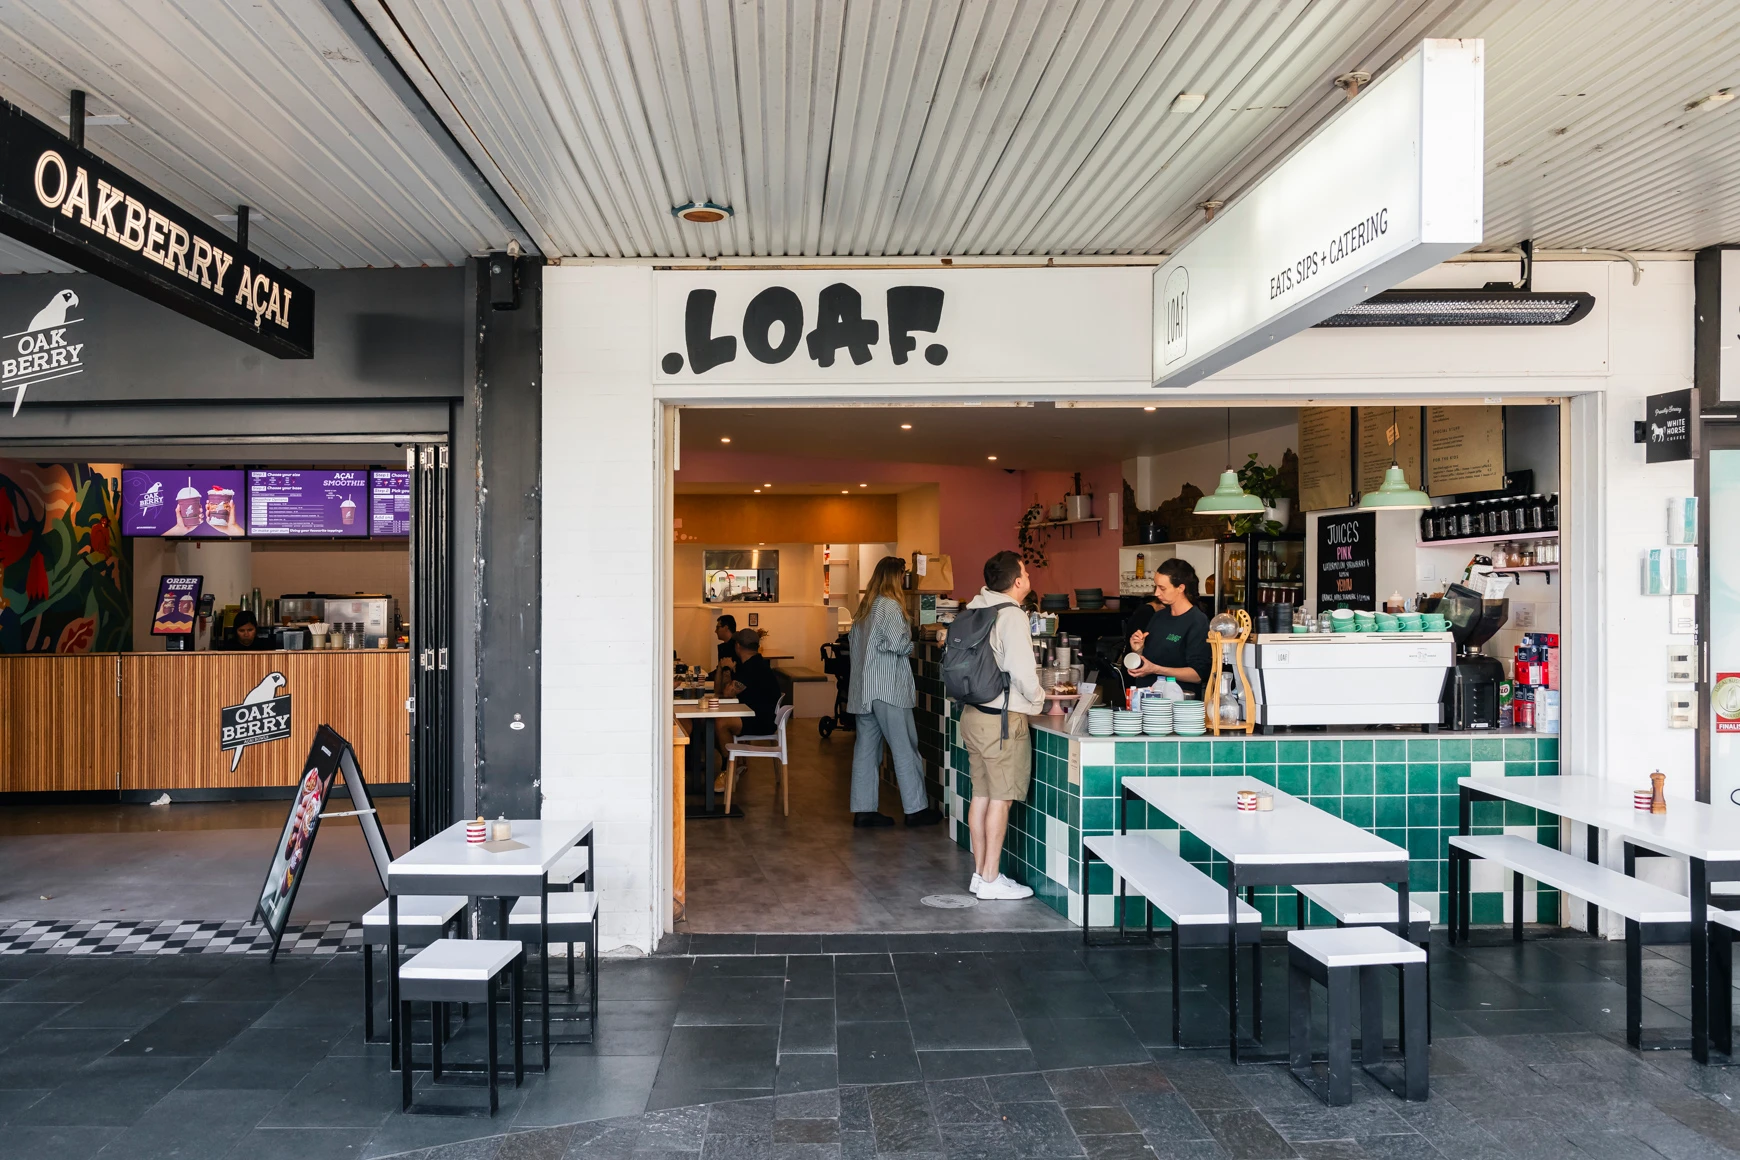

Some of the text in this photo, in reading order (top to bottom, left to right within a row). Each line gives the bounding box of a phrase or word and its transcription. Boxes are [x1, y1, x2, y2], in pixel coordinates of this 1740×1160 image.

[34, 149, 293, 329] OAKBERRY AÇAI
[1270, 207, 1389, 300] EATS, SIPS + CATERING
[1167, 291, 1186, 346] LOAF
[17, 327, 68, 355] OAK
[2, 343, 84, 379] BERRY
[1666, 418, 1686, 428] WHITE
[1666, 426, 1686, 435] HORSE
[139, 496, 164, 505] BERRY
[1327, 520, 1359, 545] JUICES
[1337, 545, 1352, 561] PINK
[235, 702, 276, 723] OAK
[222, 714, 290, 742] BERRY
